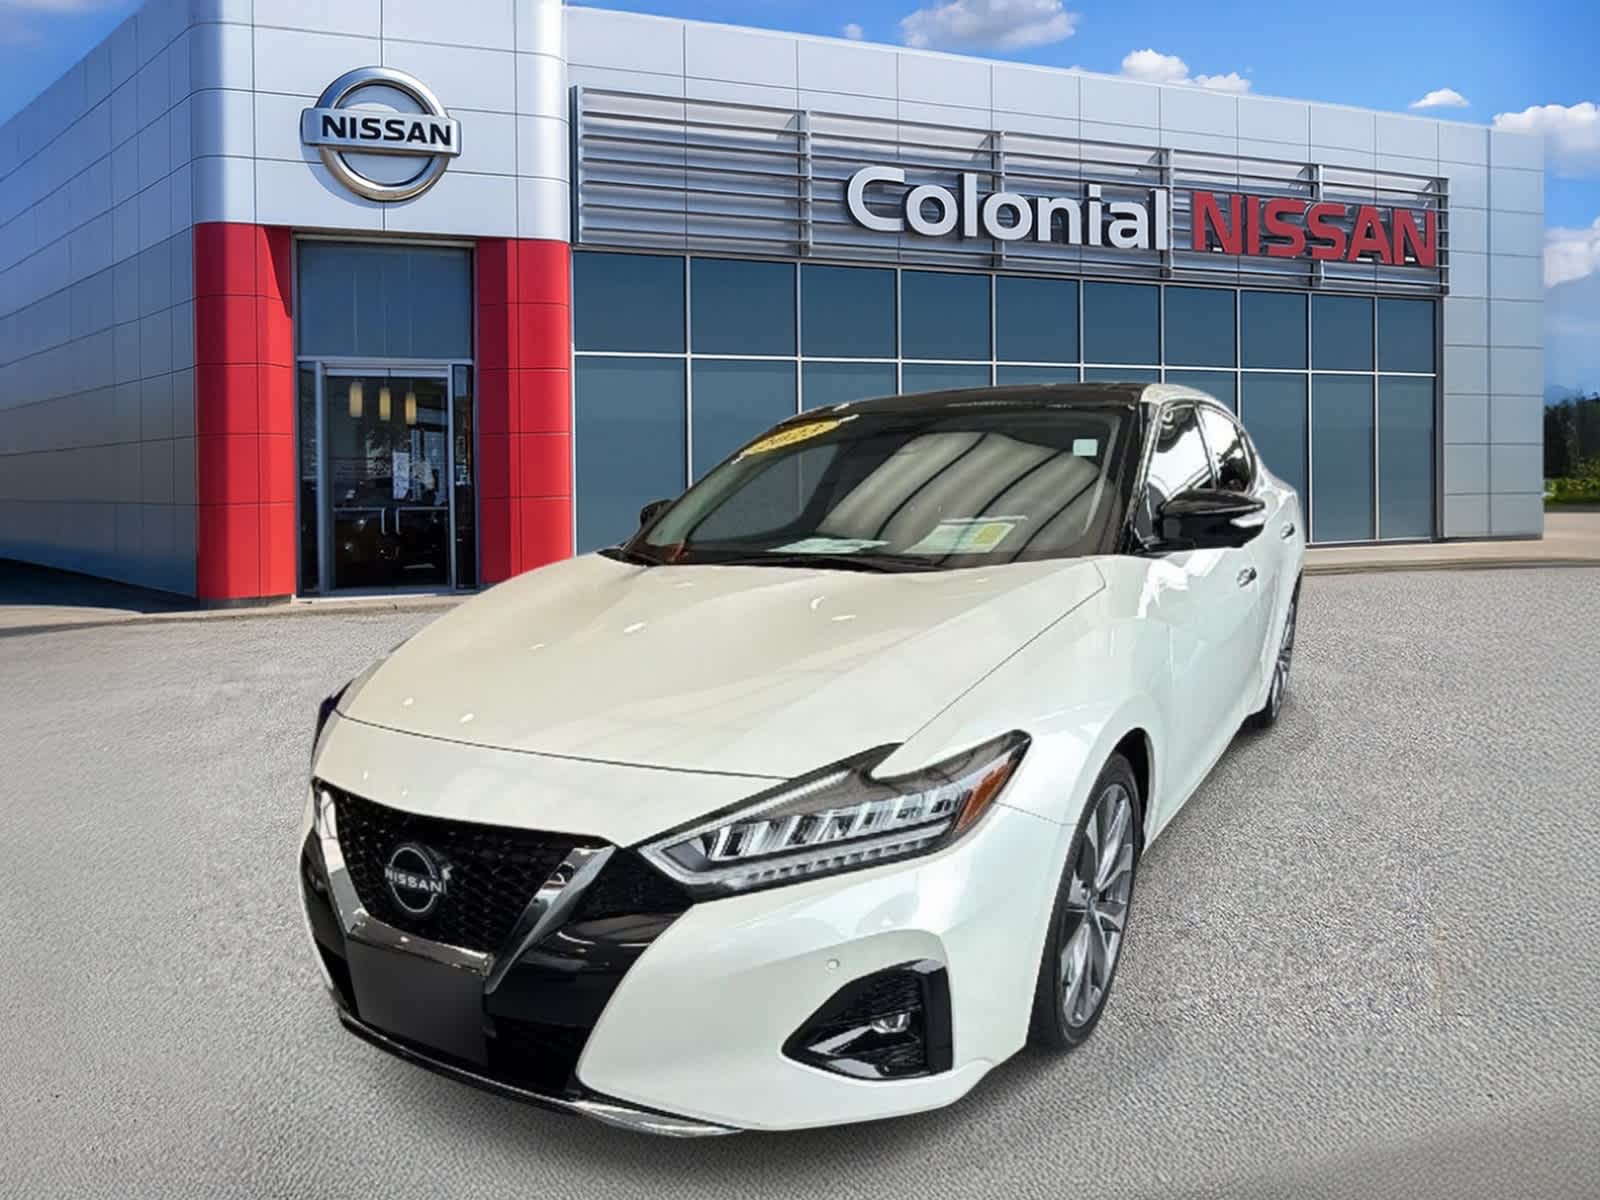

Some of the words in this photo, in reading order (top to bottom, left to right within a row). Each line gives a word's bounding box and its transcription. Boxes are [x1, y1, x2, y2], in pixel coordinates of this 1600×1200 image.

[321, 115, 452, 146] NISSAN
[847, 166, 1168, 251] Colonial
[1191, 190, 1436, 266] NISSAN
[384, 867, 443, 893] NISSAN
